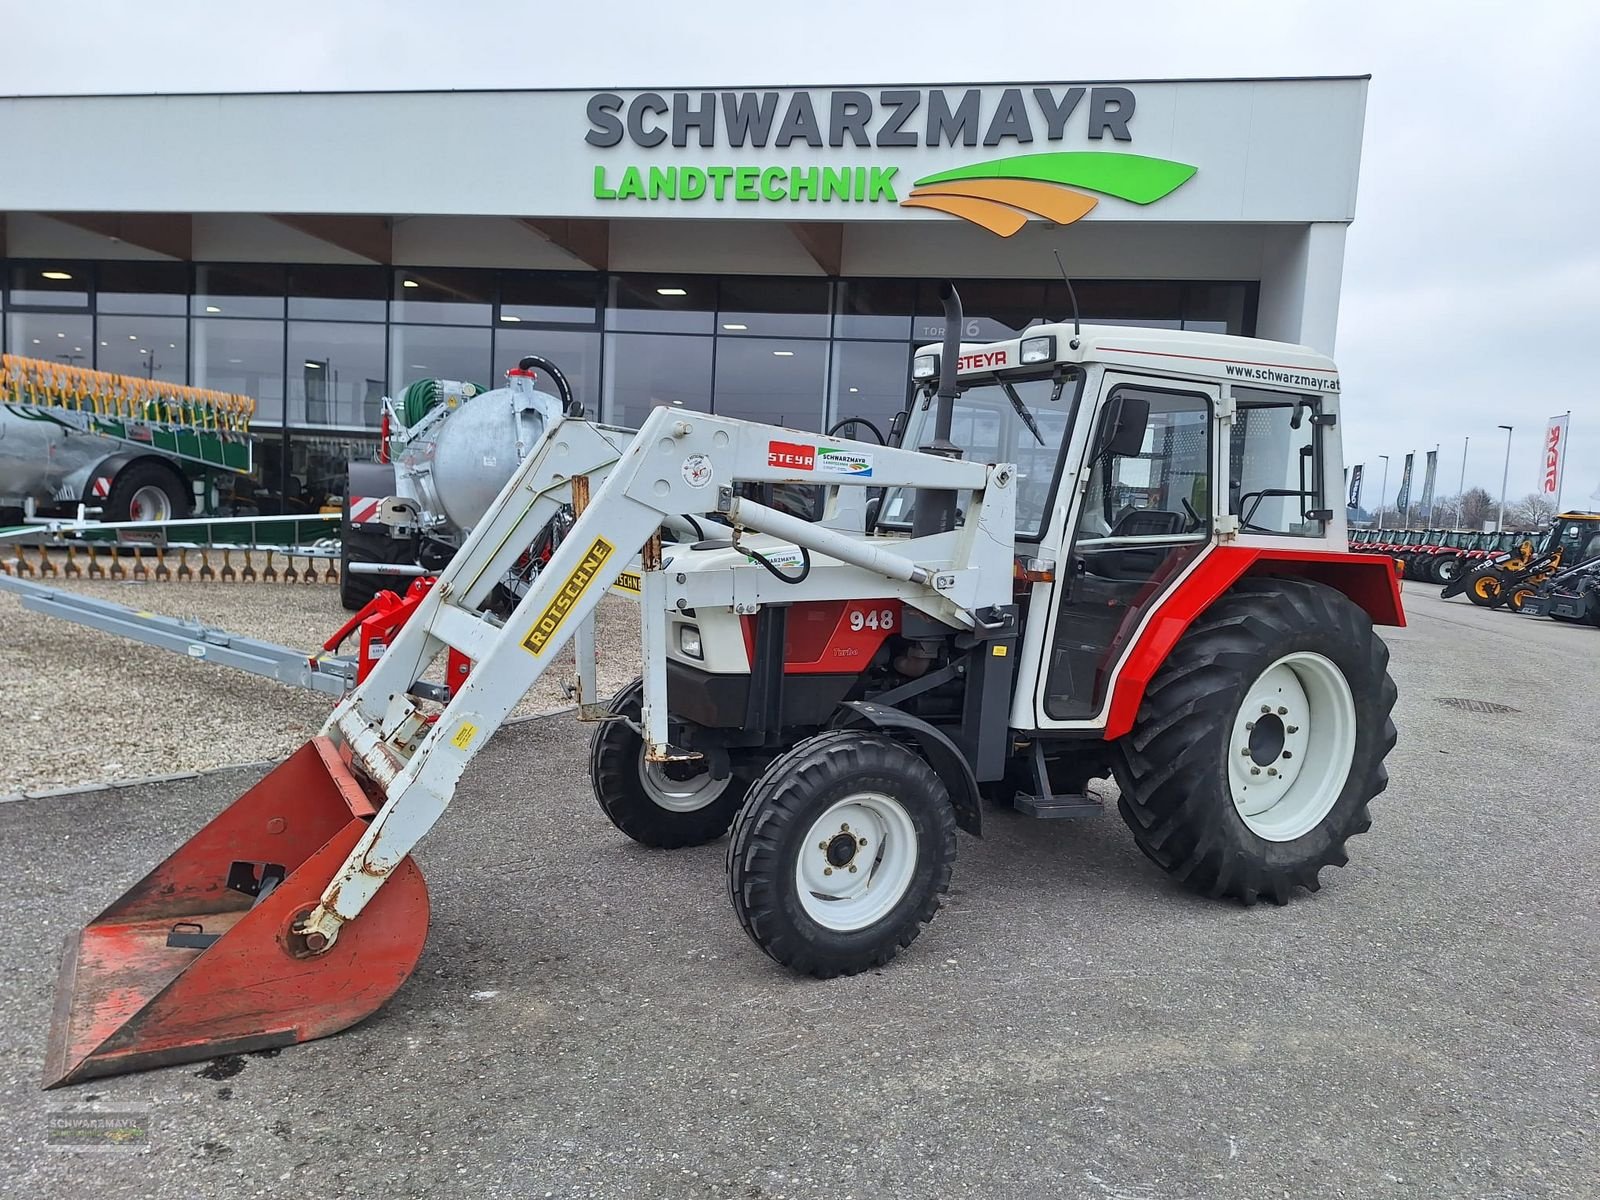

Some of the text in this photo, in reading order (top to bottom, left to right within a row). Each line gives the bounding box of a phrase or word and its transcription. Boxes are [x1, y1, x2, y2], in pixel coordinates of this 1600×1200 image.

[585, 87, 1137, 149] SCHWARZMAYR
[593, 165, 899, 202] LANDTECHNIK
[957, 351, 1007, 370] STEYR
[1225, 364, 1340, 391] www.schwarzmayr.at
[768, 453, 813, 466] STEYR
[823, 454, 866, 464] SCHWARZMAYR
[754, 555, 796, 566] SARZMAYR
[616, 575, 641, 590] SCHNE
[530, 543, 607, 649] ROTSCHNE
[850, 609, 894, 632] 948
[833, 647, 859, 657] Turbo
